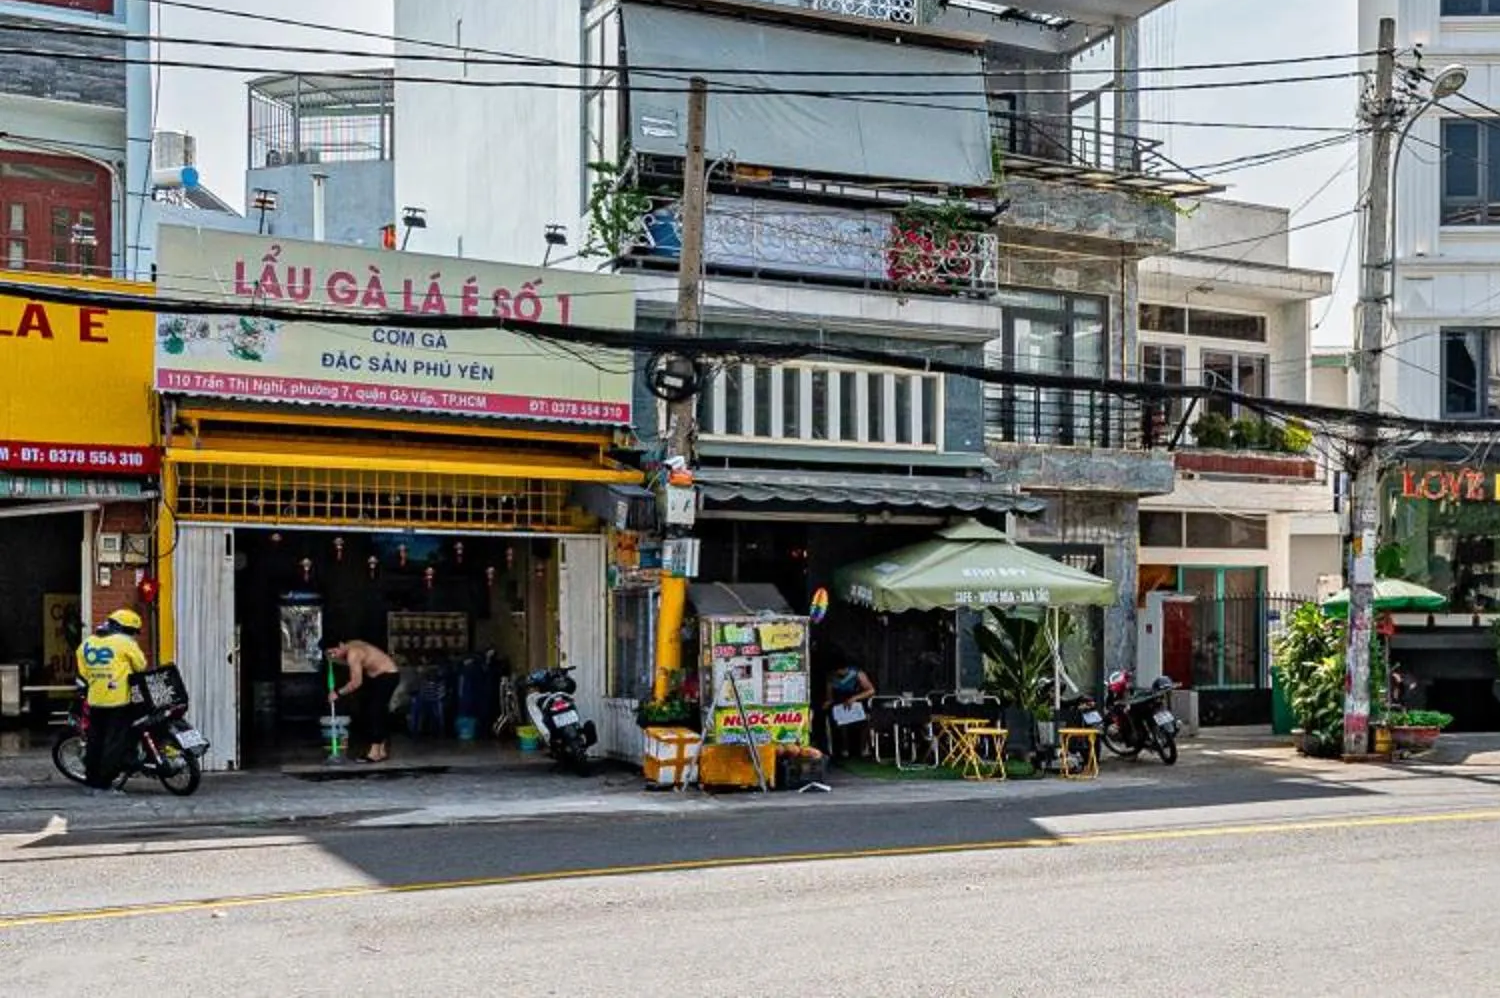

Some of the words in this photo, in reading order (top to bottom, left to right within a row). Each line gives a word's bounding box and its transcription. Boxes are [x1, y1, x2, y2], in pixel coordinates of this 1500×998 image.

[235, 245, 312, 302] LẨU
[326, 265, 388, 309] GÀ
[402, 272, 447, 315] LÁ
[491, 278, 543, 324] SỐ
[557, 293, 573, 327] 1
[321, 352, 362, 372] ĐẶC
[368, 352, 407, 374] SẢN
[413, 358, 451, 378] PHÚ
[457, 361, 494, 381] YÊN
[168, 372, 191, 387] 110
[227, 377, 249, 393] Thị
[551, 402, 578, 415] 0378
[580, 404, 601, 417] 554
[603, 405, 623, 418] 310
[49, 449, 86, 464] 0378
[89, 451, 116, 465] 554
[119, 452, 143, 466] 310
[1399, 467, 1486, 501] LOVE
[83, 641, 115, 666] be
